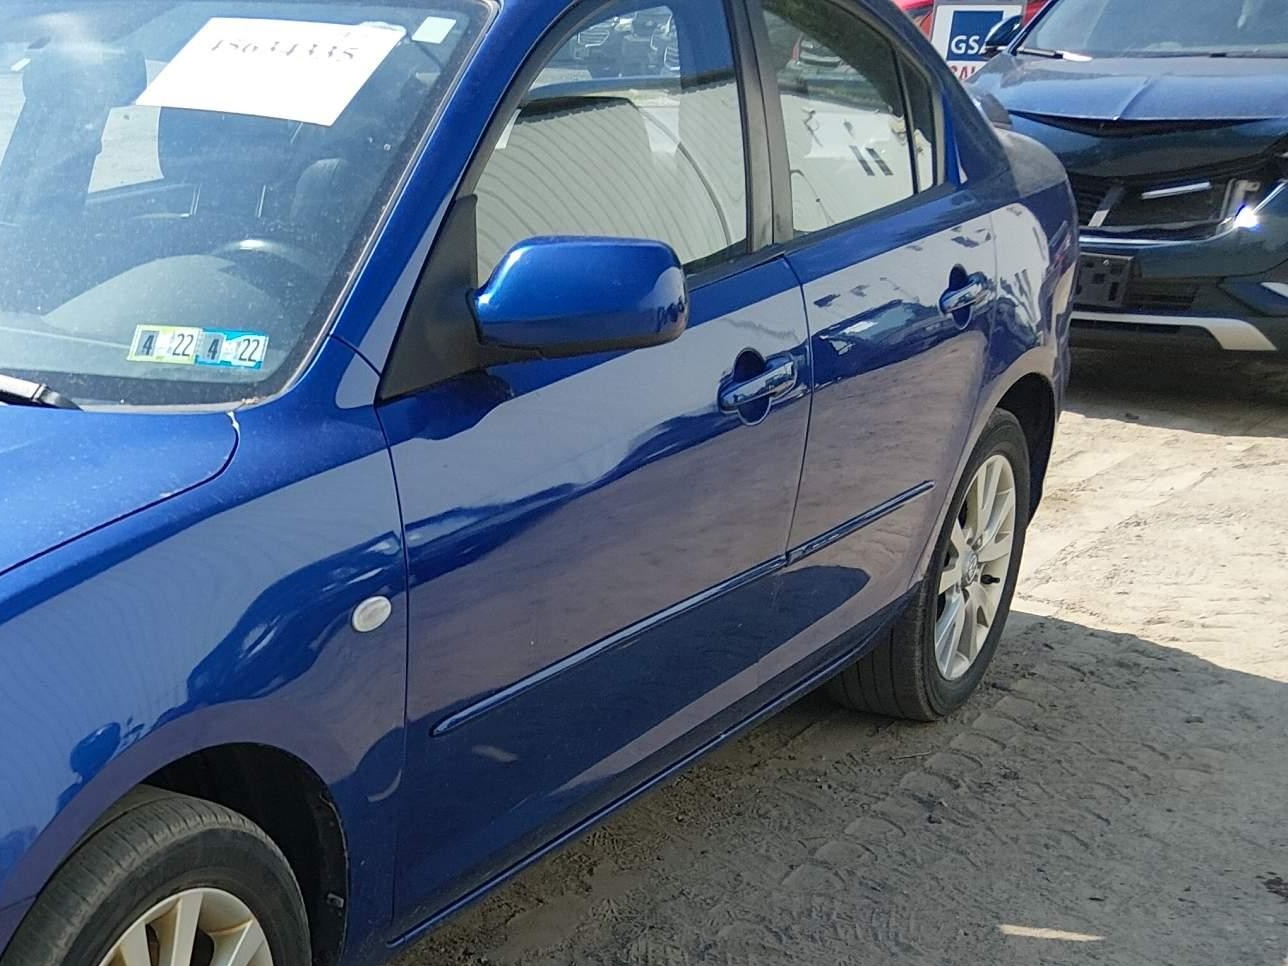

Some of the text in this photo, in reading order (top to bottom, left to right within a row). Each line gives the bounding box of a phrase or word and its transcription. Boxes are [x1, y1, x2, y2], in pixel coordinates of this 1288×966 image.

[142, 333, 194, 357] 4 22
[207, 338, 260, 362] 4 22
